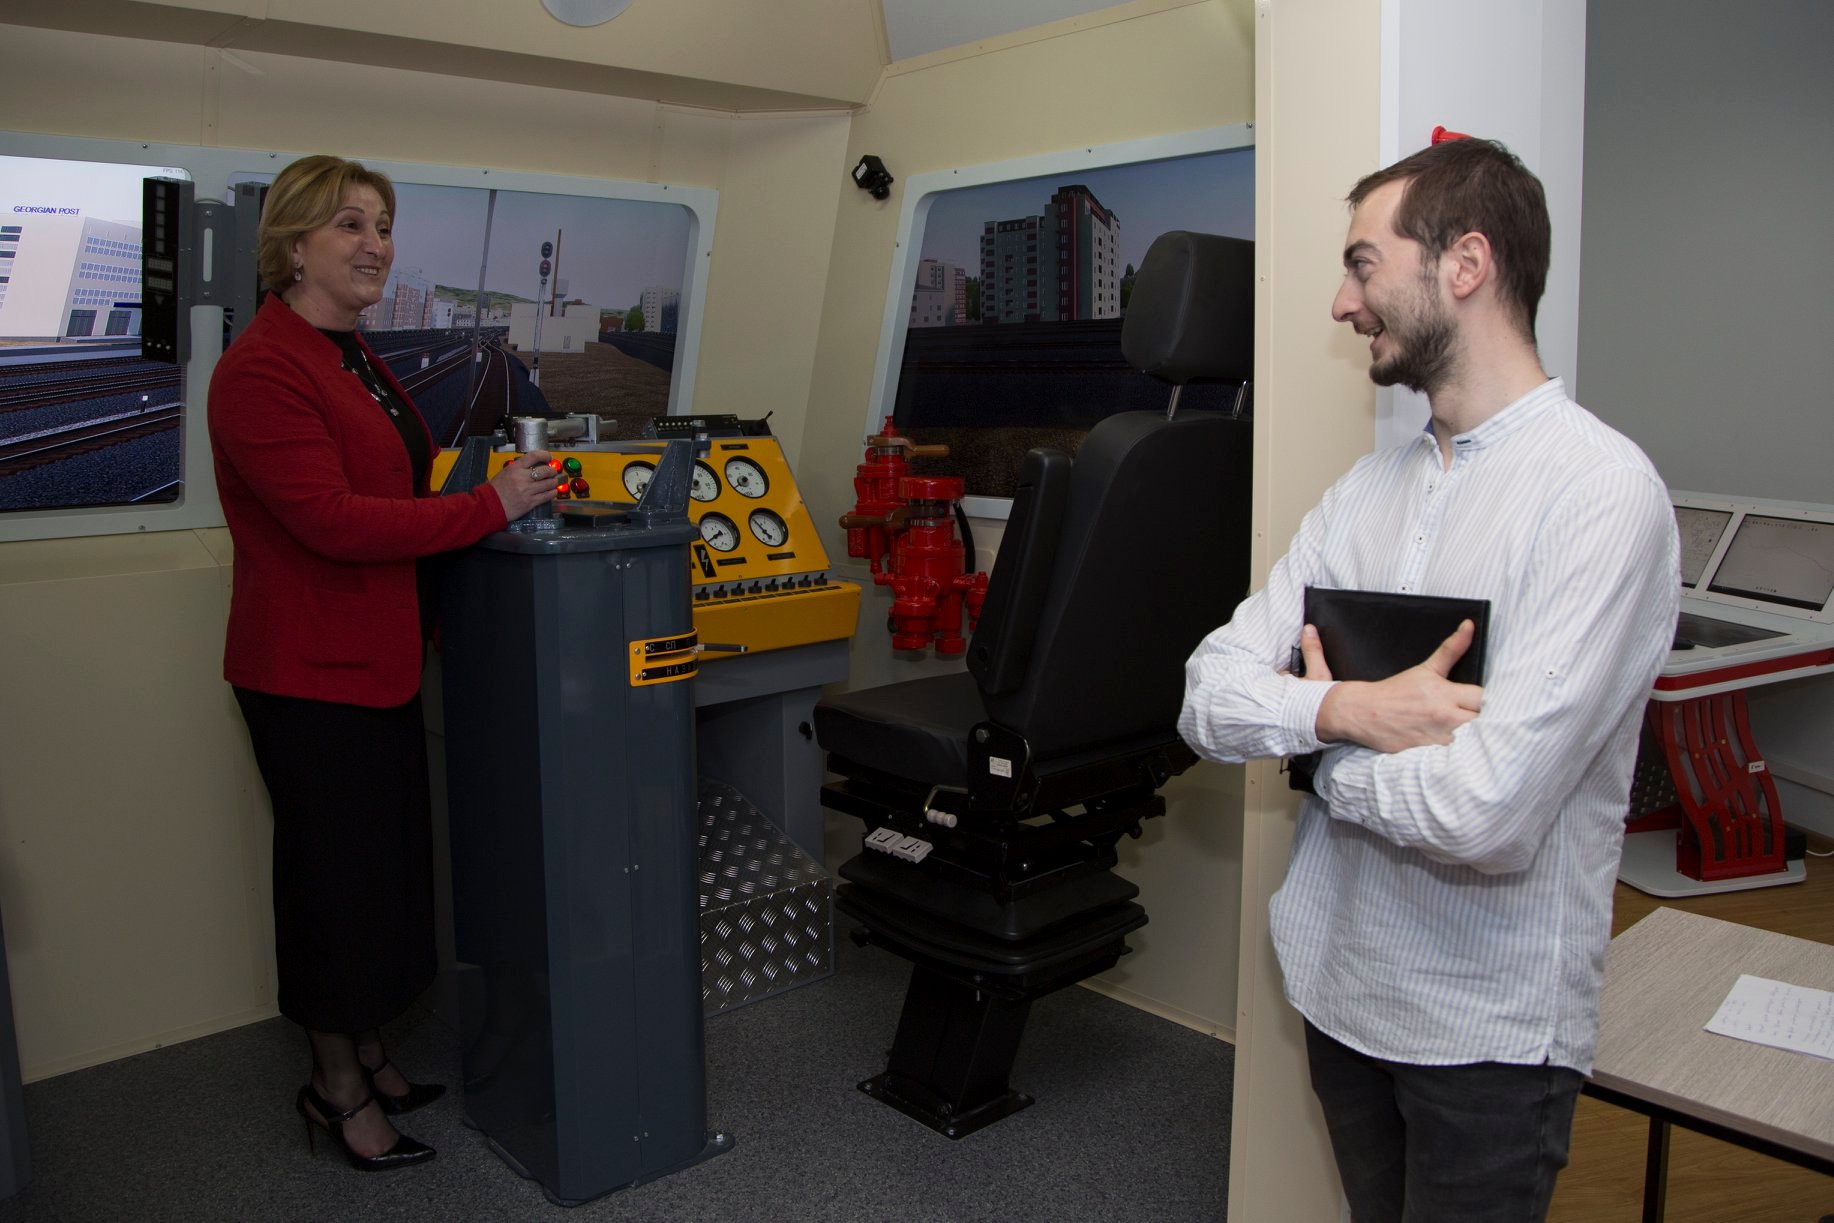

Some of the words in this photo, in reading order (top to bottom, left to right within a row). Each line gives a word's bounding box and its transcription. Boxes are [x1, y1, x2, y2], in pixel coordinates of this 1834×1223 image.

[13, 205, 57, 214] GEORGIAN
[58, 207, 80, 215] POST
[665, 640, 677, 650] СП
